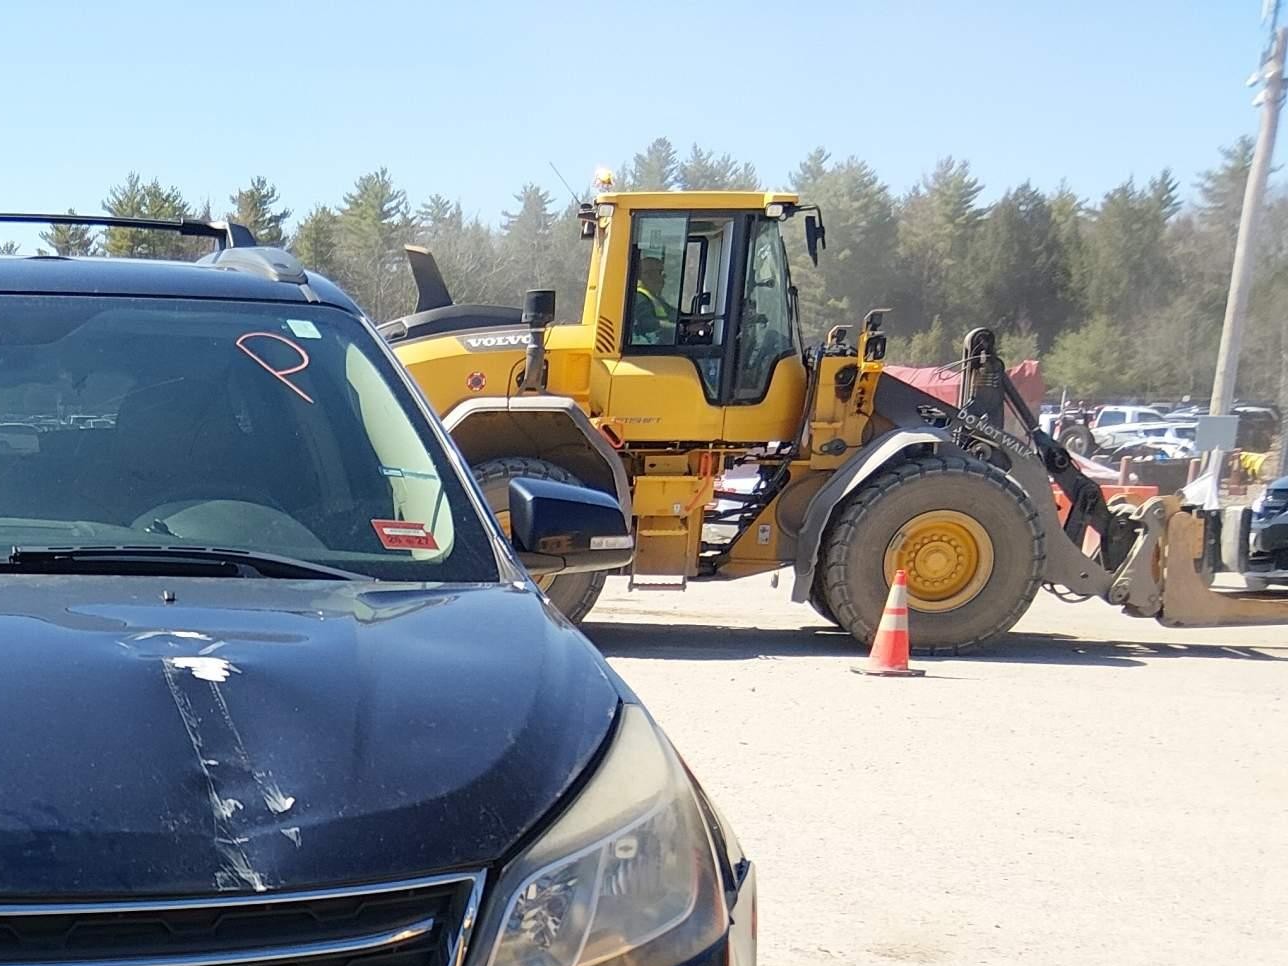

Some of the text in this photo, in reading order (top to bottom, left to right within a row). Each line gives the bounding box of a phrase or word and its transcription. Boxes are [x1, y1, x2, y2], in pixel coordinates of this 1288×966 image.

[466, 333, 532, 347] VOLVO
[957, 409, 1034, 460] DO NOT WALK
